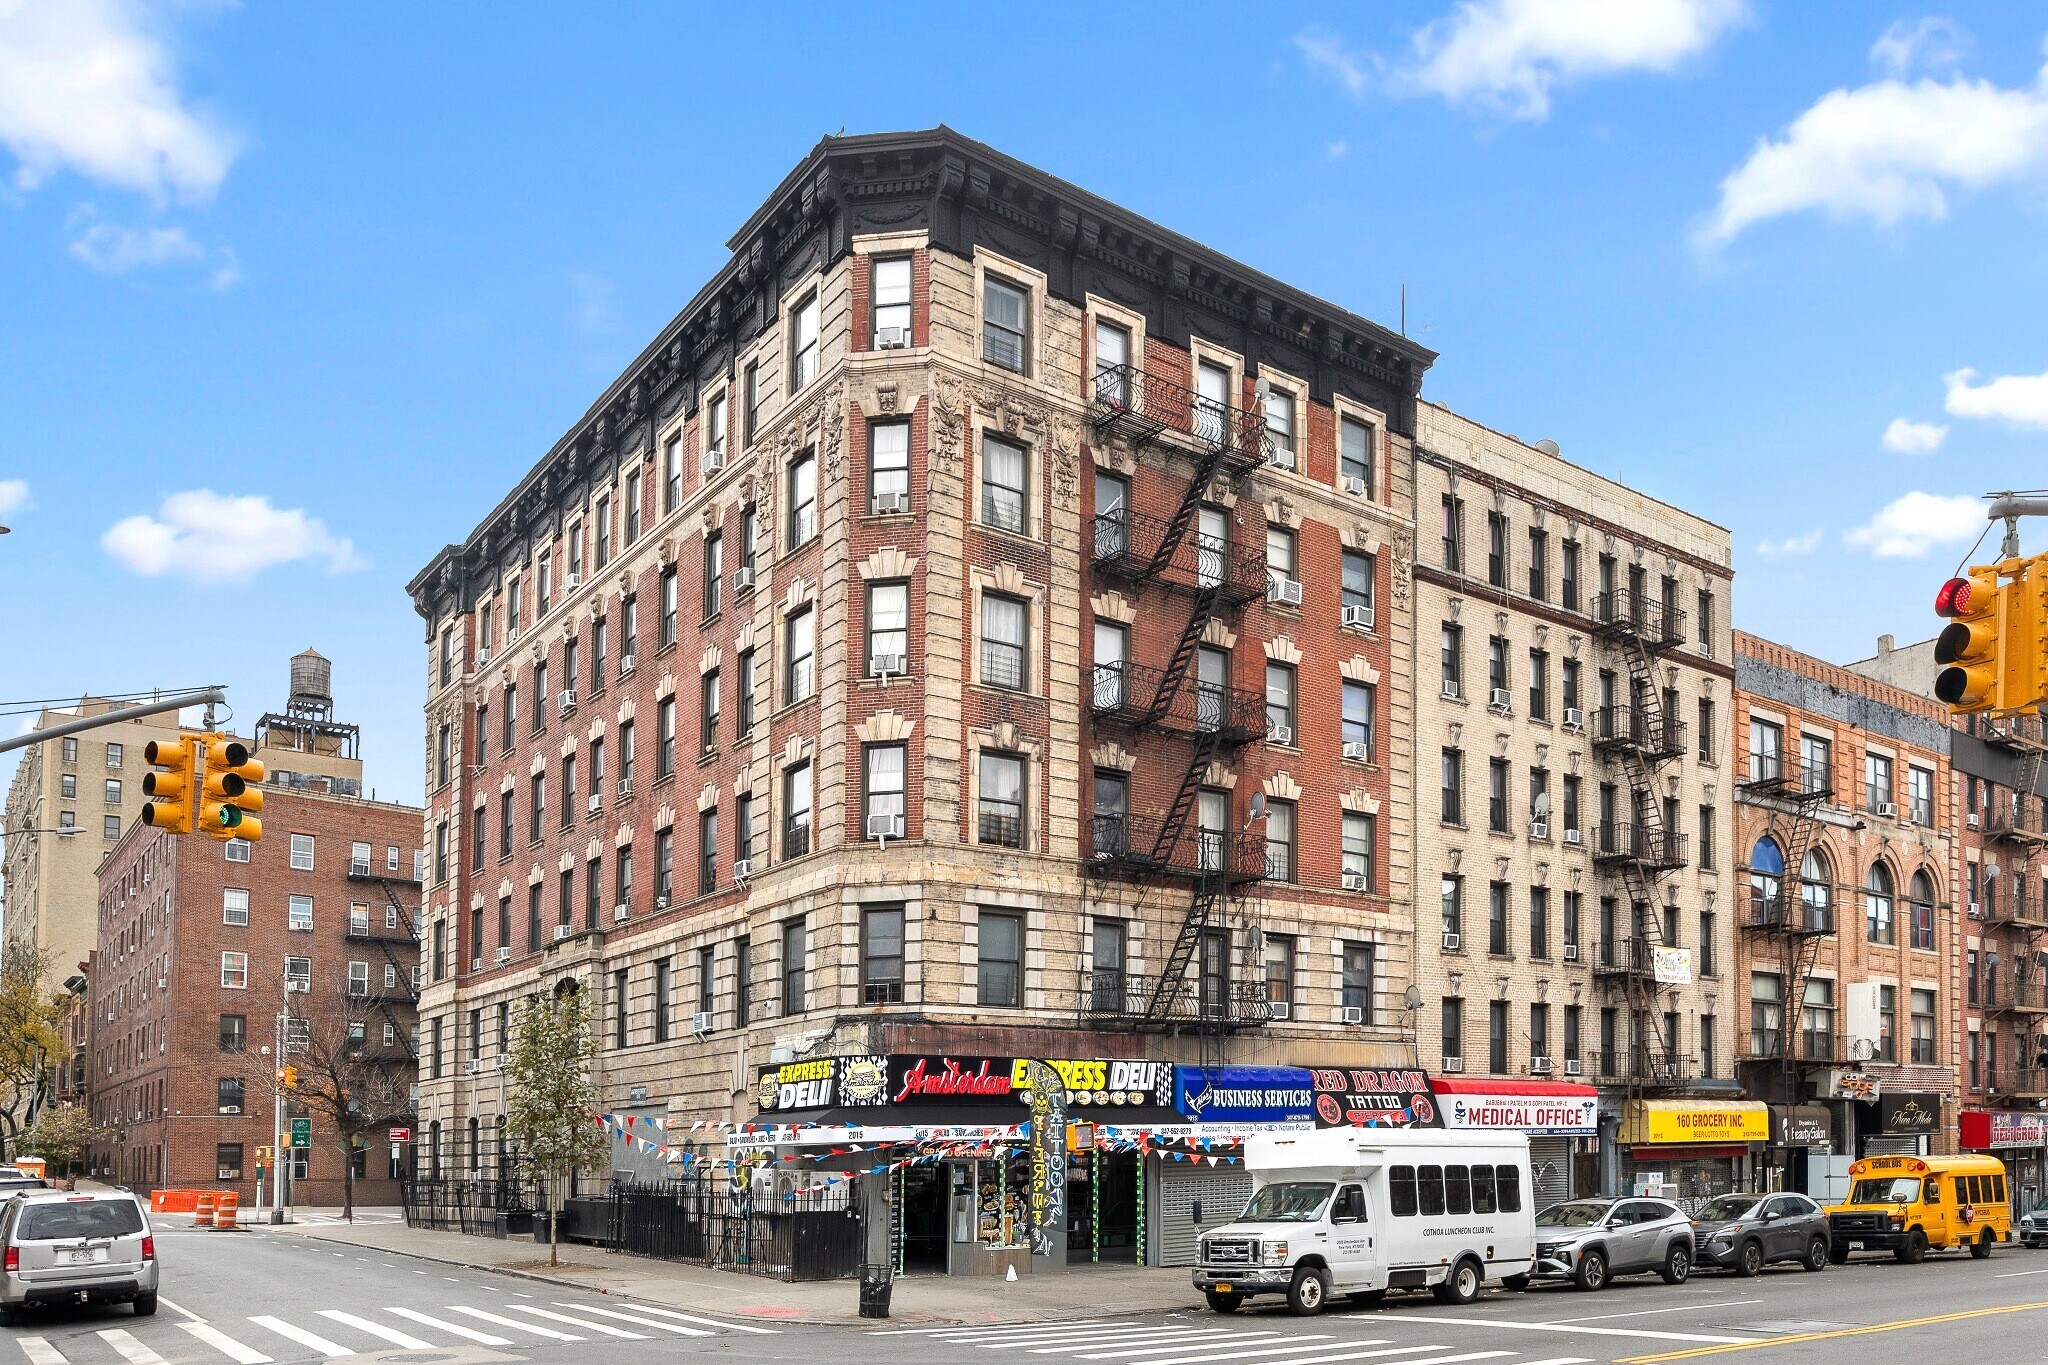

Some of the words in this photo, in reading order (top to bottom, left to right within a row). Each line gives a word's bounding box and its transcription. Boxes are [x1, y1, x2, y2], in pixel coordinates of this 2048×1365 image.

[779, 1060, 832, 1083] EXPRESS
[894, 1057, 1012, 1102] Amsterdam
[1109, 1061, 1157, 1091] DELI
[1310, 1070, 1348, 1092] RED
[1350, 1070, 1429, 1093] DRAGON
[778, 1079, 833, 1109] DELI
[1213, 1089, 1262, 1107] BUSINESS
[1264, 1089, 1311, 1107] SERVICES
[1346, 1095, 1402, 1109] TATTOO
[1468, 1108, 1532, 1126] MEDICAL
[1536, 1108, 1583, 1126] OFFICE
[1677, 1114, 1691, 1128] 160
[1692, 1114, 1728, 1128] GROCERY
[1729, 1114, 1745, 1128] INC.
[849, 1131, 863, 1139] 2015
[1201, 1124, 1231, 1133] Accounting
[1234, 1124, 1254, 1132] Income
[1278, 1124, 1295, 1133] Notary
[1295, 1124, 1311, 1132] Public
[1810, 1126, 1826, 1139] Salon
[1992, 1126, 2015, 1142] DELI
[1872, 1160, 1891, 1169] SCHOOL
[1891, 1159, 1902, 1168] BUS
[1423, 1228, 1444, 1237] COTHOA
[1444, 1227, 1471, 1236] LUNCHEON
[1472, 1226, 1485, 1235] CLUB
